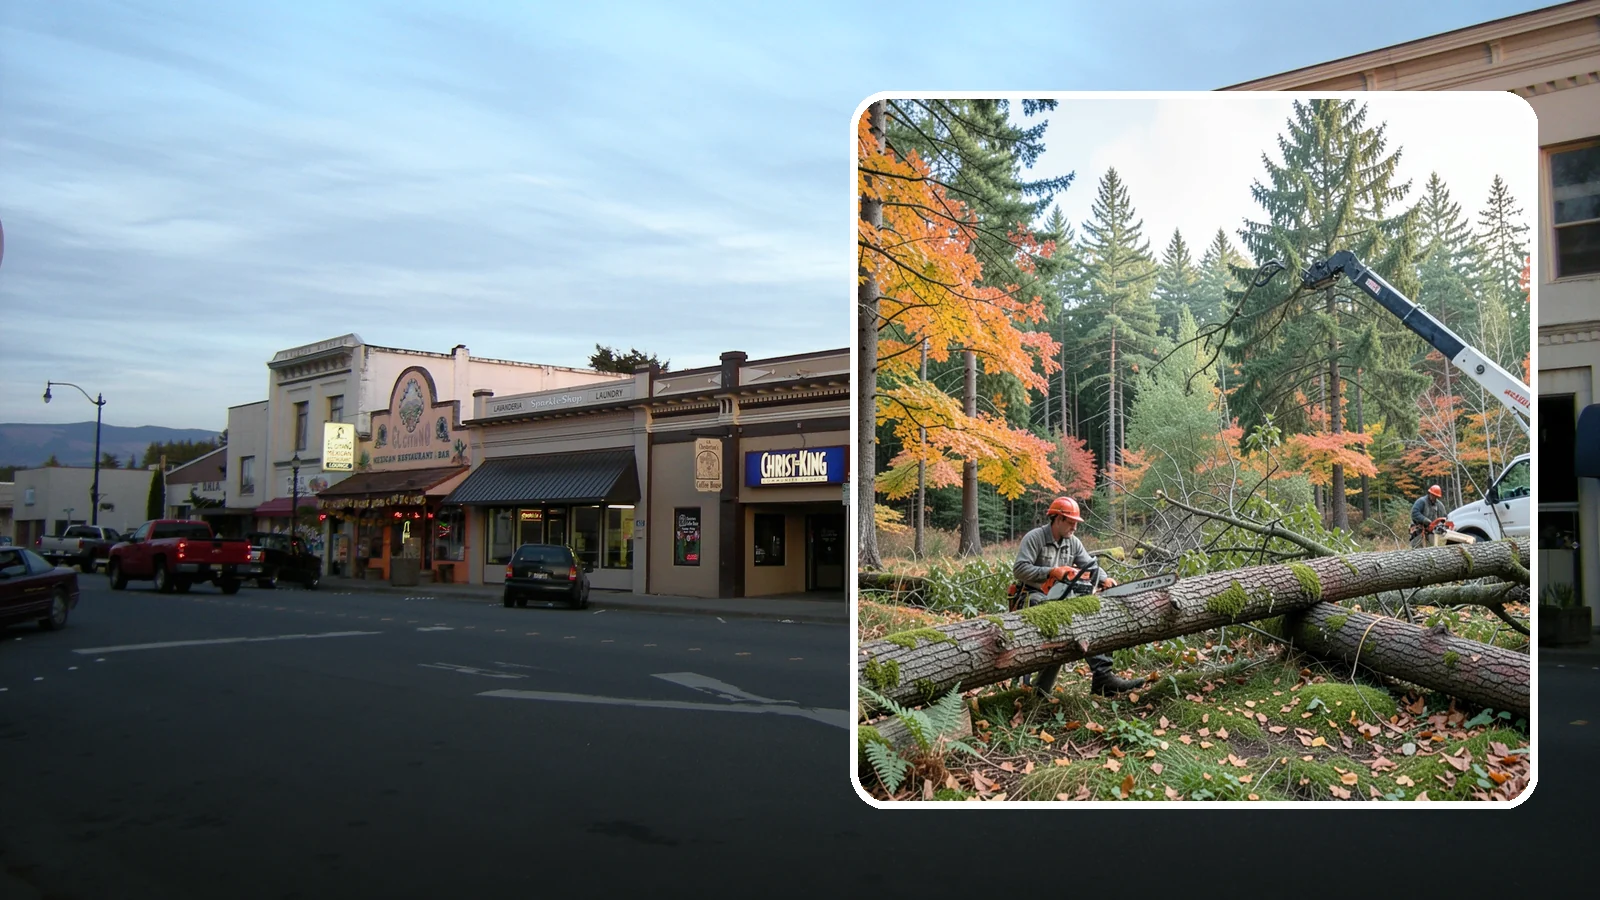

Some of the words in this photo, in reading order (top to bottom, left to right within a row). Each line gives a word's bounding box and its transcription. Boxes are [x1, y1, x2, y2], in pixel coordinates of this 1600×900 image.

[562, 394, 583, 404] Shop
[596, 389, 624, 400] LAUNDRY
[493, 402, 523, 413] LAVANDERIA
[373, 455, 396, 464] MEXICAN
[397, 451, 434, 462] RESTAURANT
[438, 450, 450, 459] BAR
[761, 452, 798, 478] CHRIST
[799, 450, 827, 476] KING
